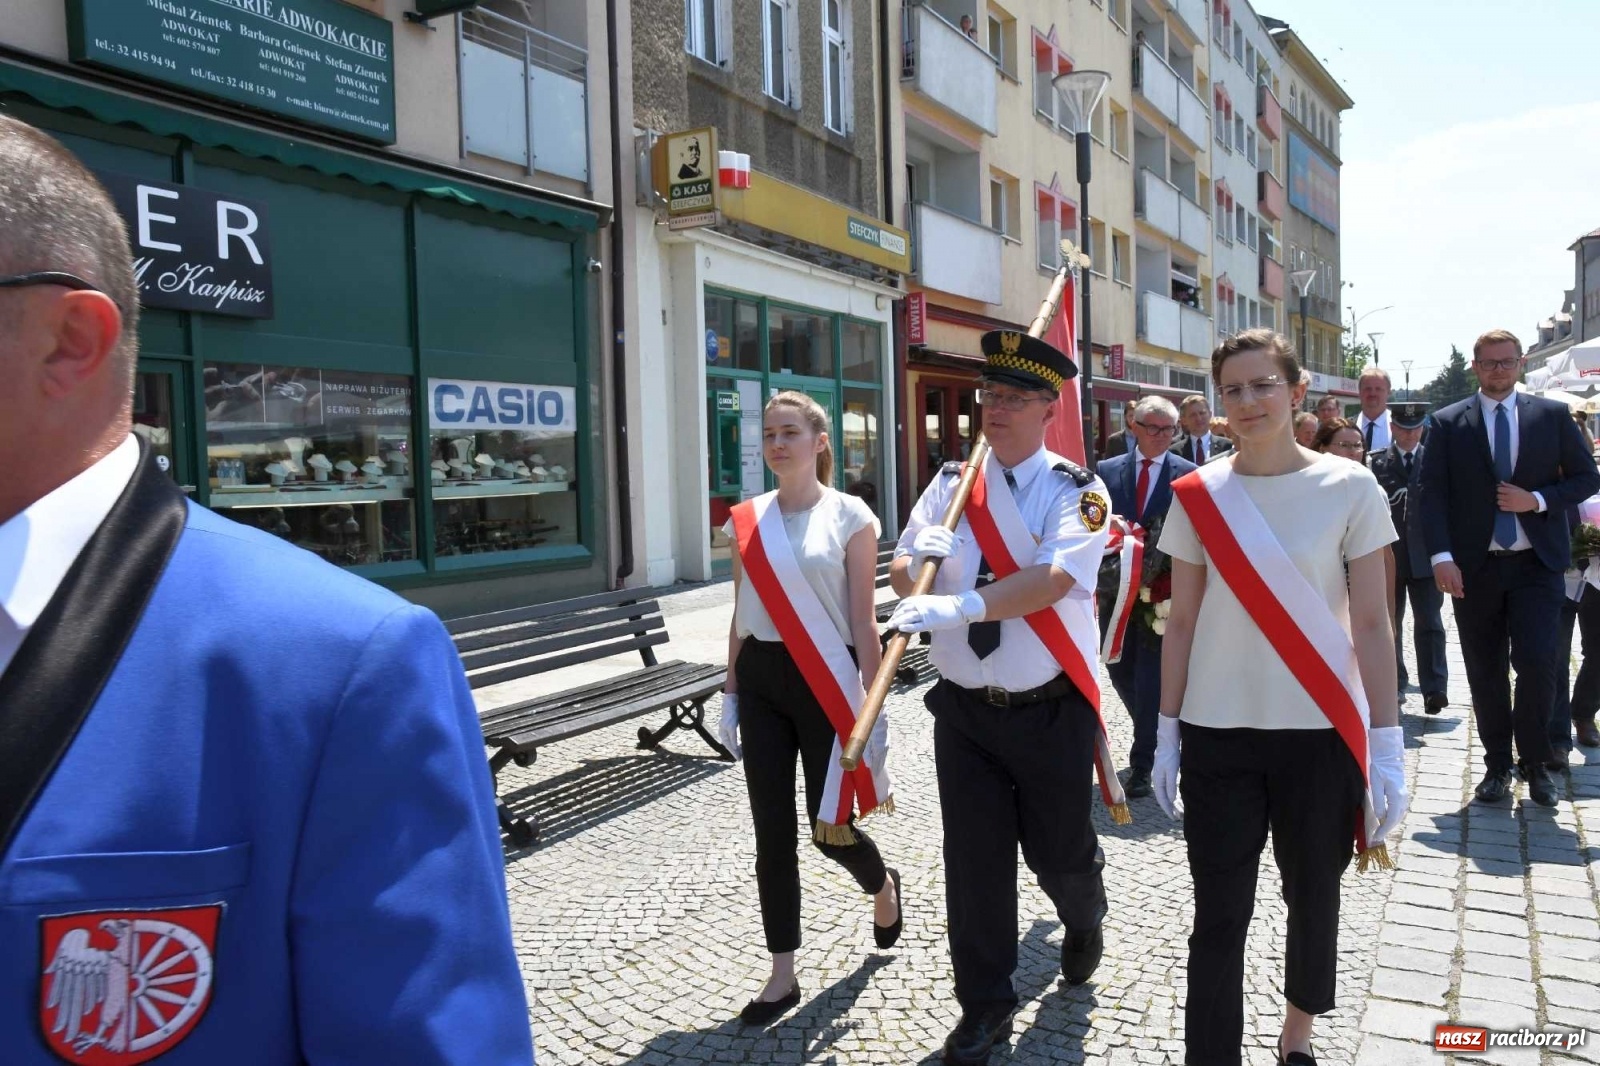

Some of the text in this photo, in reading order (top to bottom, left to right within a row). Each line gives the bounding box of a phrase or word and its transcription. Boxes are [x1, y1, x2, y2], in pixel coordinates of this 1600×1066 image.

[160, 18, 220, 44] ADWOKAT
[189, 8, 233, 32] Zientek
[278, 6, 387, 59] ADWOKACKIE
[95, 38, 177, 70] tel.: 32 415 94 94
[176, 37, 191, 48] 602
[240, 23, 321, 62] Barbara Gniewek
[258, 47, 307, 72] ADWOKAT
[325, 54, 388, 84] Stefan Zientek
[226, 76, 238, 88] 32
[238, 80, 254, 93] 418
[256, 84, 266, 96] 15
[266, 87, 277, 99] 30
[334, 73, 380, 95] ADWOKAT
[683, 182, 710, 196] KASY
[850, 221, 879, 244] STEFCZYK
[157, 262, 266, 309] Karpisz
[910, 296, 921, 340] ŻYWIEC
[325, 383, 368, 394] NAPRAWA
[326, 405, 360, 415] SERWIS
[434, 384, 563, 425] CASIO
